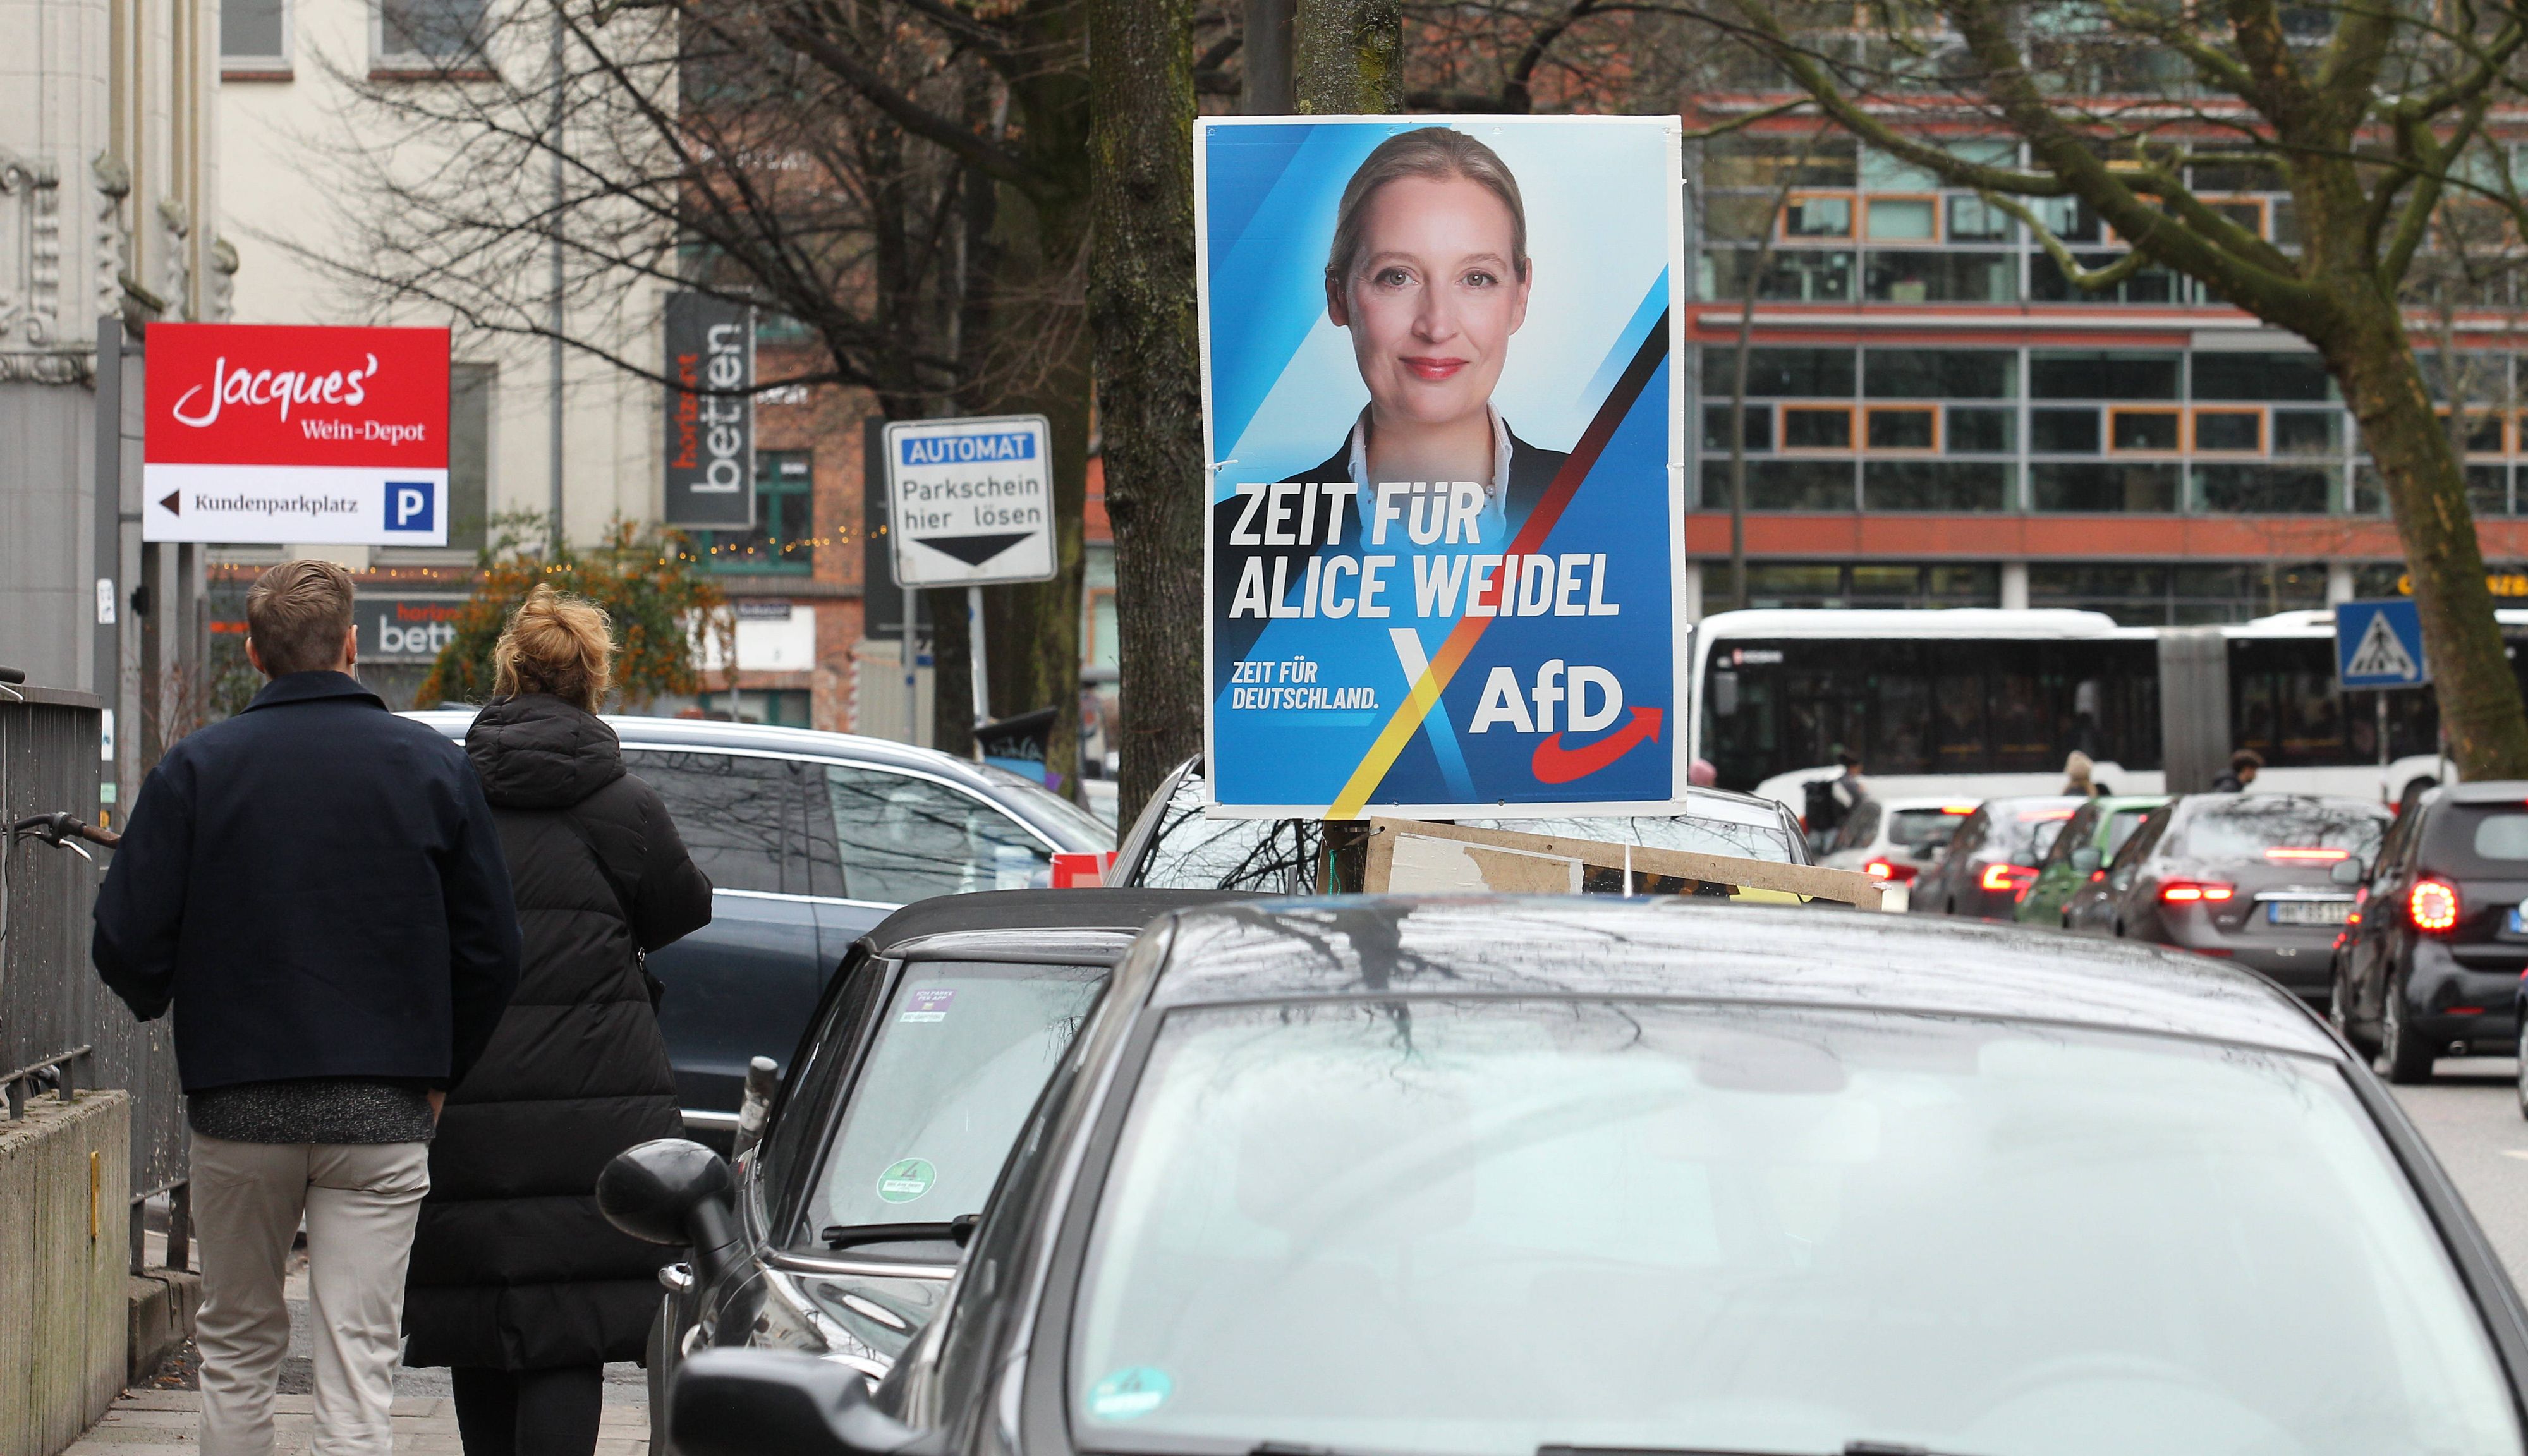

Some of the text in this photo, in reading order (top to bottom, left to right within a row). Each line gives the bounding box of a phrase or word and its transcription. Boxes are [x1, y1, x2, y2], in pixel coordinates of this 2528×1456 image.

[173, 352, 379, 428] Jacques'
[301, 418, 426, 446] Wein-Depot
[909, 434, 1027, 464] AUTOMAT
[902, 475, 1039, 501] Parkschein
[195, 488, 425, 526] Kundenparkplatz P
[904, 505, 1042, 531] hier lösen
[1229, 481, 1485, 546] ZEIT FÜR
[1228, 553, 1620, 619] ALICE WEIDEL
[379, 613, 458, 654] bett
[1231, 655, 1318, 684] ZEIT FÜR
[1232, 687, 1380, 710] DEUTSCHLAND.
[1468, 658, 1624, 734] AfD
[900, 1161, 920, 1179] 4
